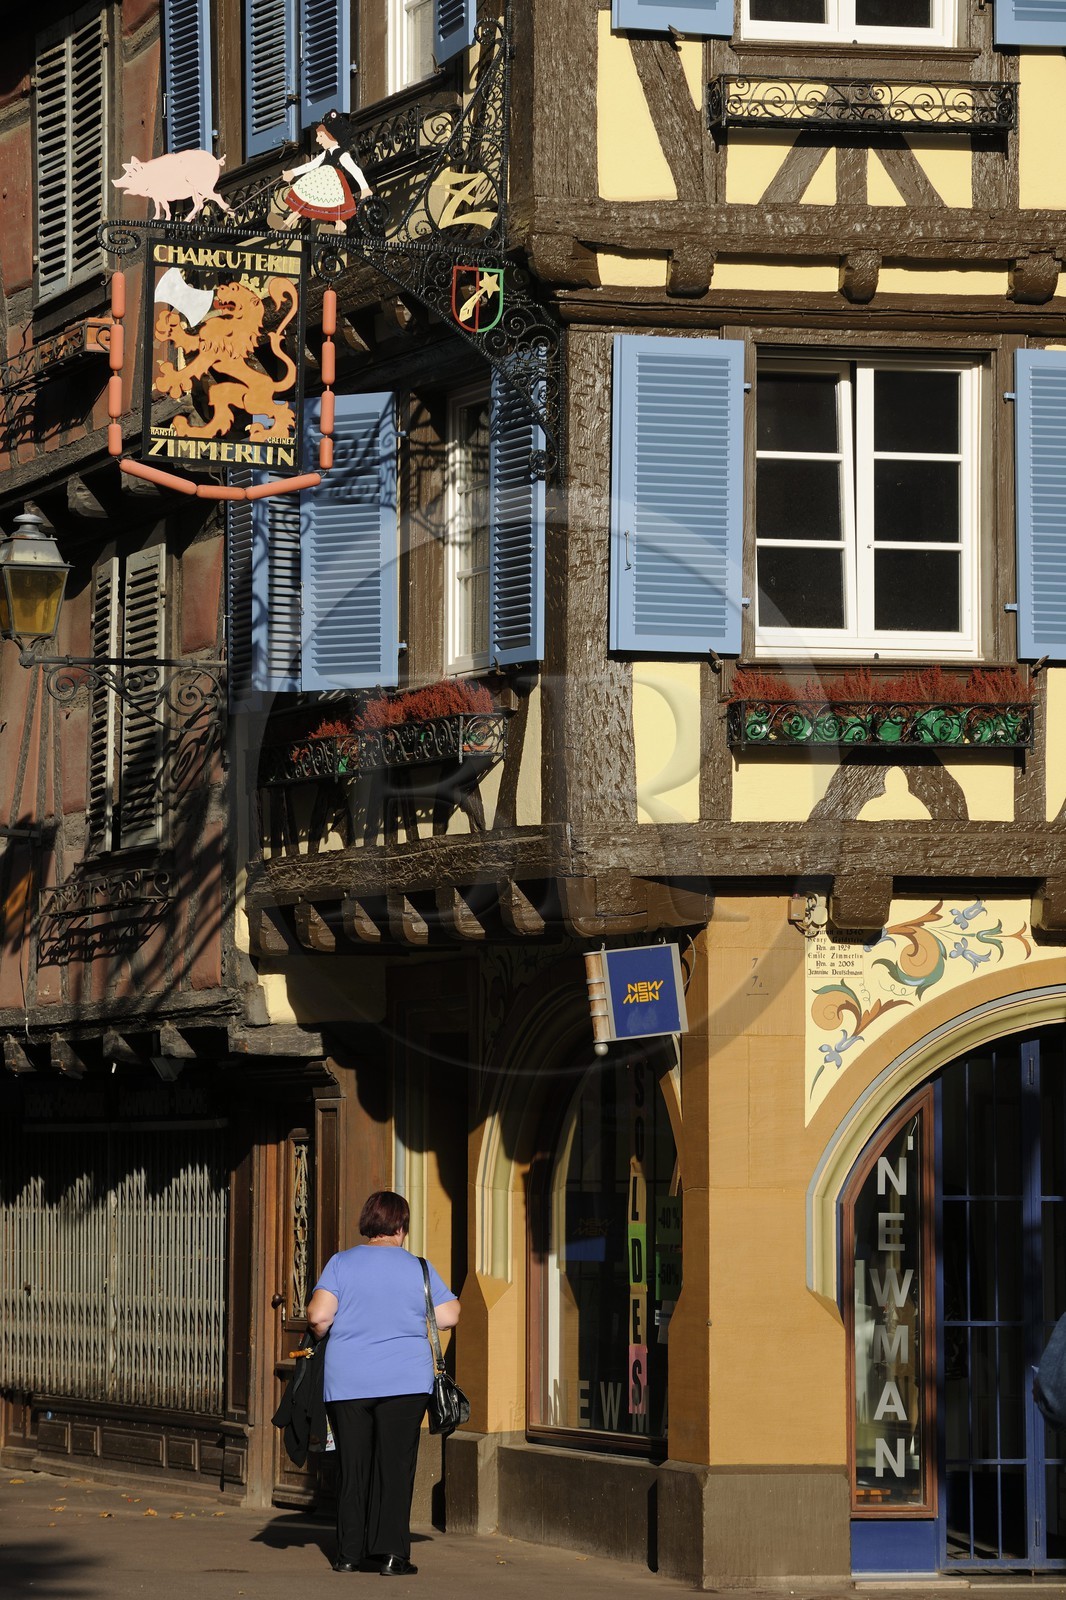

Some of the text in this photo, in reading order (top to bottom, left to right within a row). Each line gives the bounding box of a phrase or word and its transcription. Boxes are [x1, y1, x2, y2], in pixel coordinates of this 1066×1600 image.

[153, 243, 301, 275] CHARCUTERIE
[148, 437, 295, 467] ZIMMERLIN
[627, 980, 664, 993] NEW
[630, 1061, 646, 1408] SOLDES
[868, 1156, 915, 1478] NEWMAN
